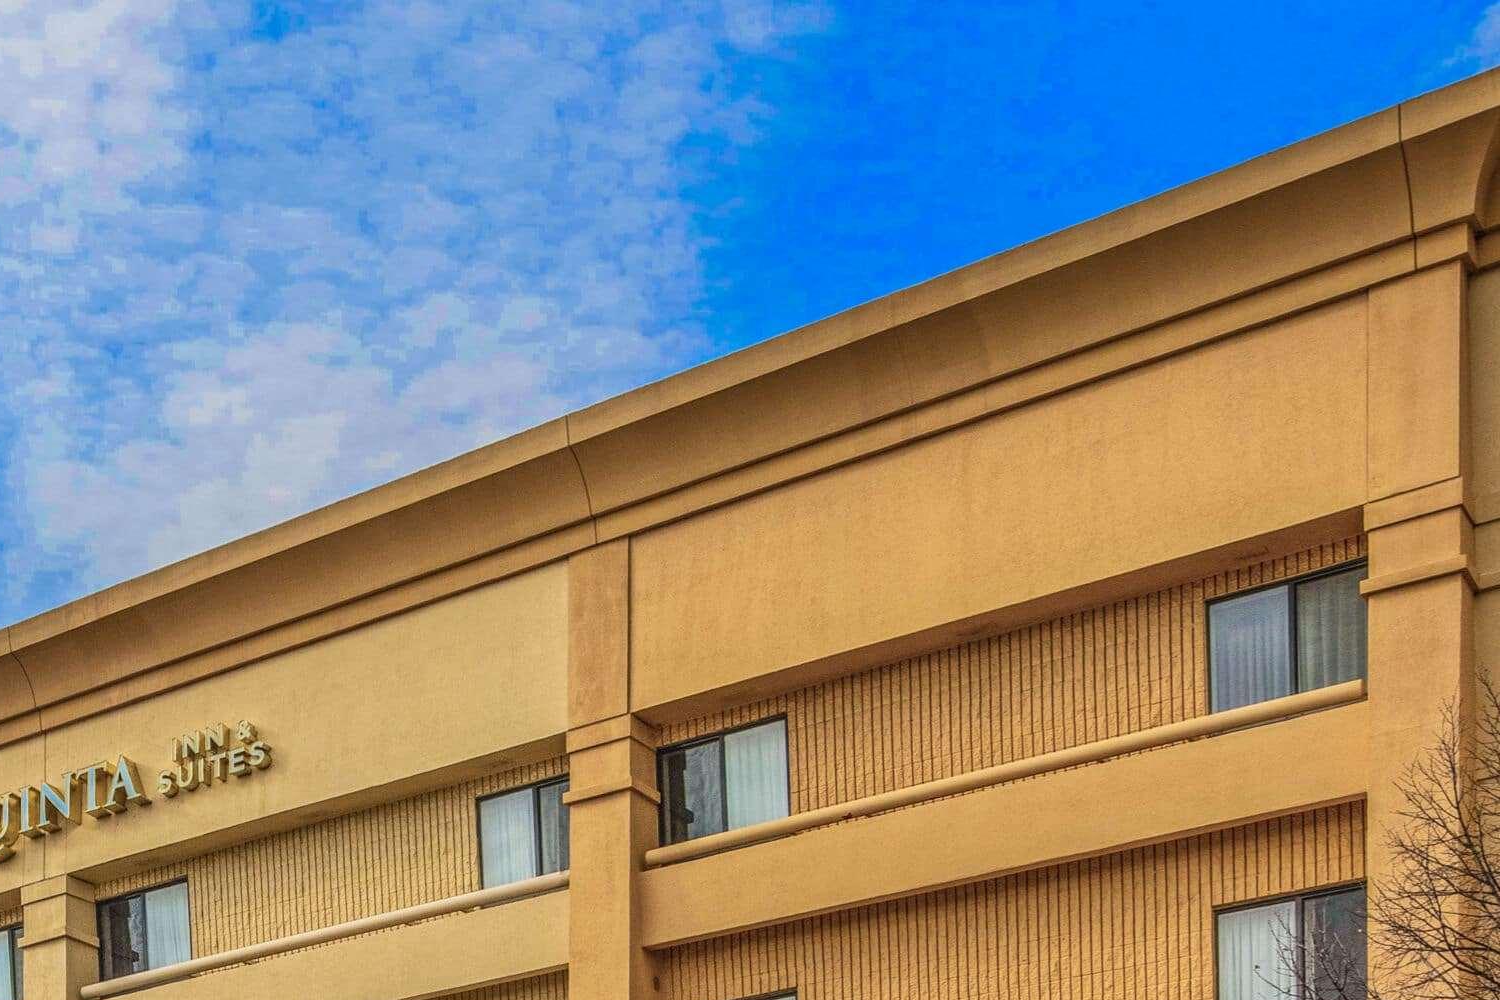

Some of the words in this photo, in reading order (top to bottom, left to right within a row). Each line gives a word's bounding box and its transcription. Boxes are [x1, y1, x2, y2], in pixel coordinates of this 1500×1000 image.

[171, 722, 227, 763] INN
[236, 719, 256, 742] &
[158, 740, 269, 796] SUITES
